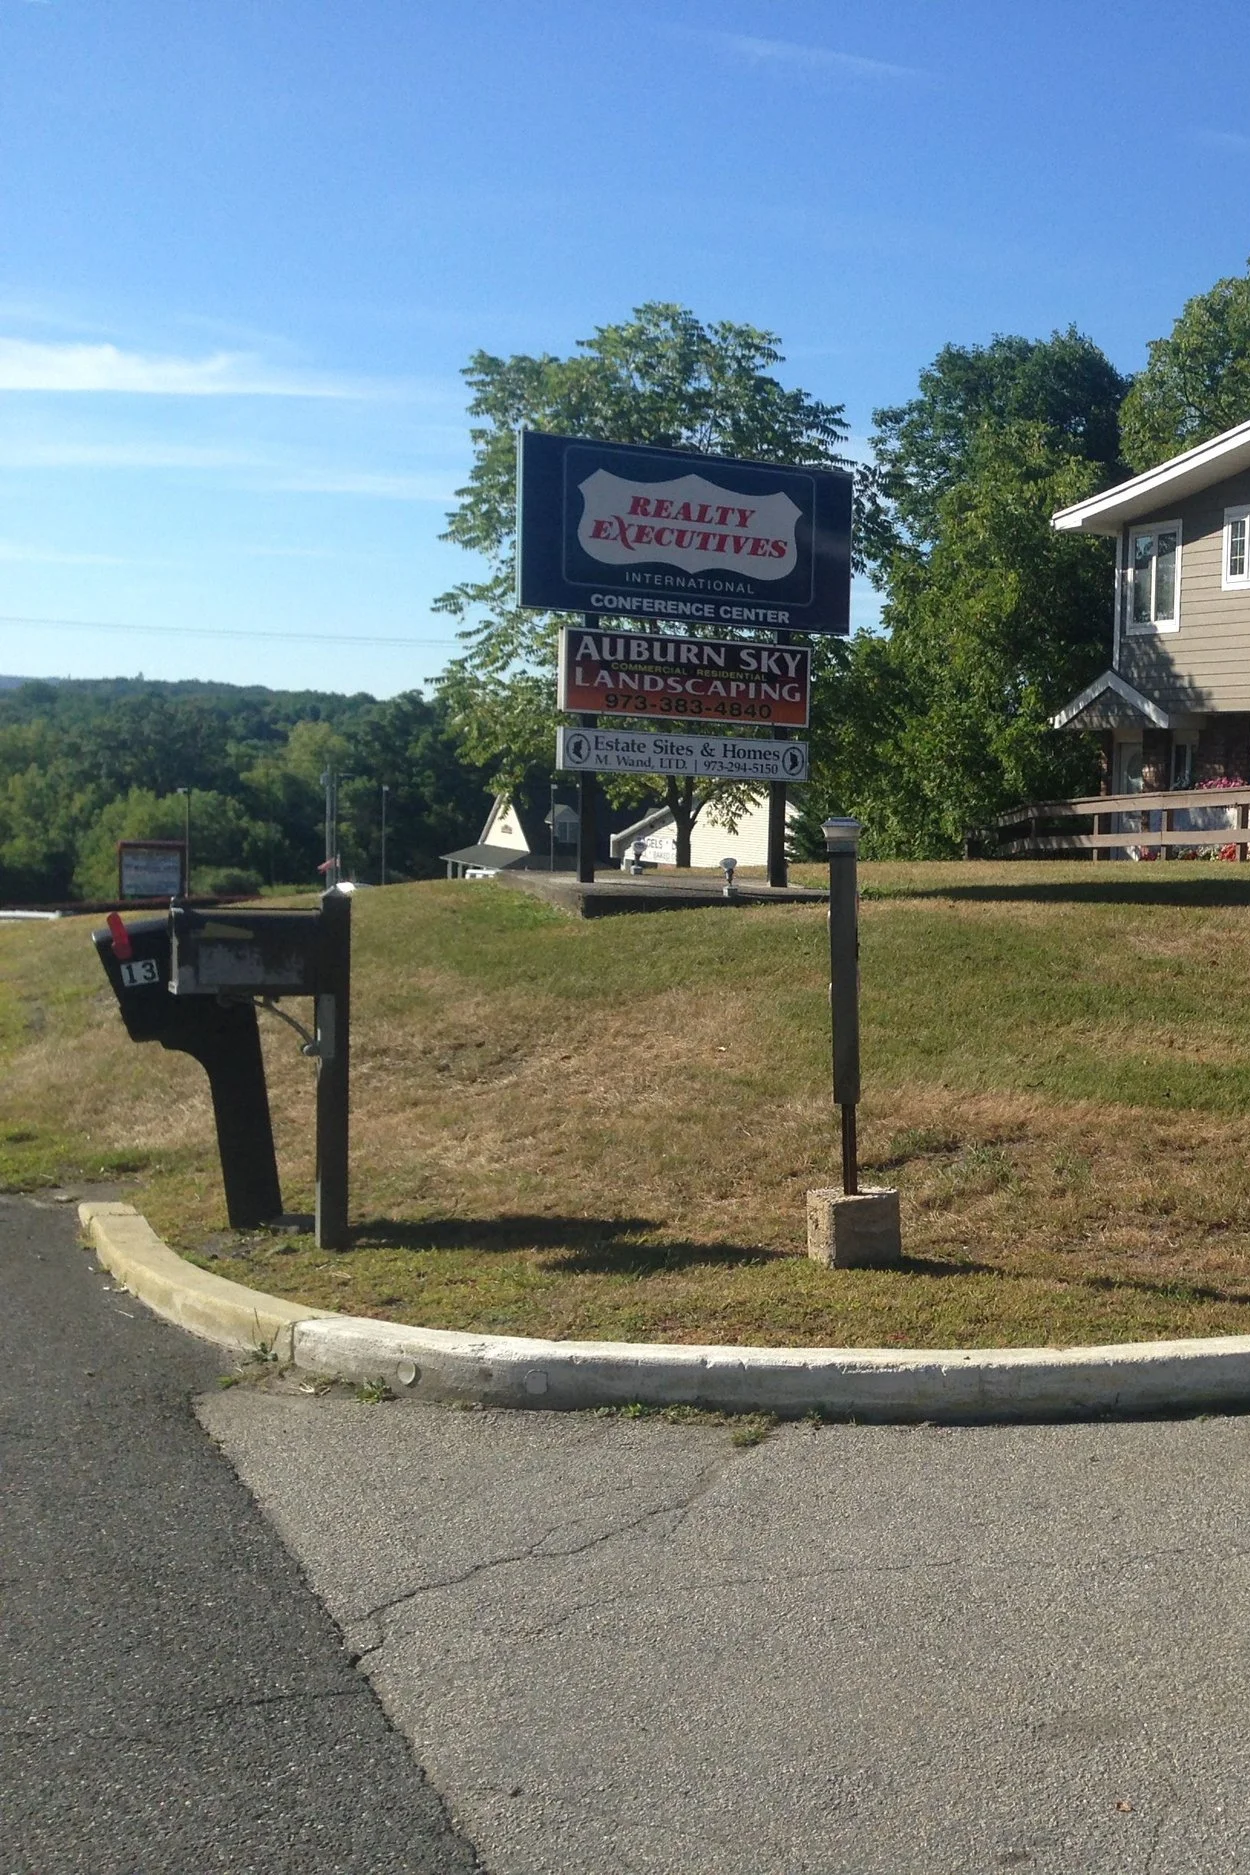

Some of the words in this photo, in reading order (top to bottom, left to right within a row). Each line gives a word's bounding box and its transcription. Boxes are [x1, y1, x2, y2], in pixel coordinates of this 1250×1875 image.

[627, 495, 756, 529] REALTY
[589, 515, 788, 558] EXECUTIVES
[625, 571, 755, 595] INTERNATIONAL
[590, 593, 716, 618] CONFERENCE
[719, 605, 790, 625] CENTER
[575, 635, 726, 668] AUBURN
[739, 648, 802, 679] SKY
[575, 666, 801, 702] LANDSCAPING
[611, 661, 688, 676] COMMERCIAL
[696, 668, 767, 682] RESIDENTIAL
[604, 692, 772, 720] 973-383-4840
[594, 735, 647, 754] Estate
[653, 739, 694, 757] Sites
[700, 742, 716, 758] &
[722, 743, 780, 761] Homes
[660, 757, 688, 770] LTD.
[703, 760, 779, 775] 973-294-5150
[125, 962, 156, 984] 13
